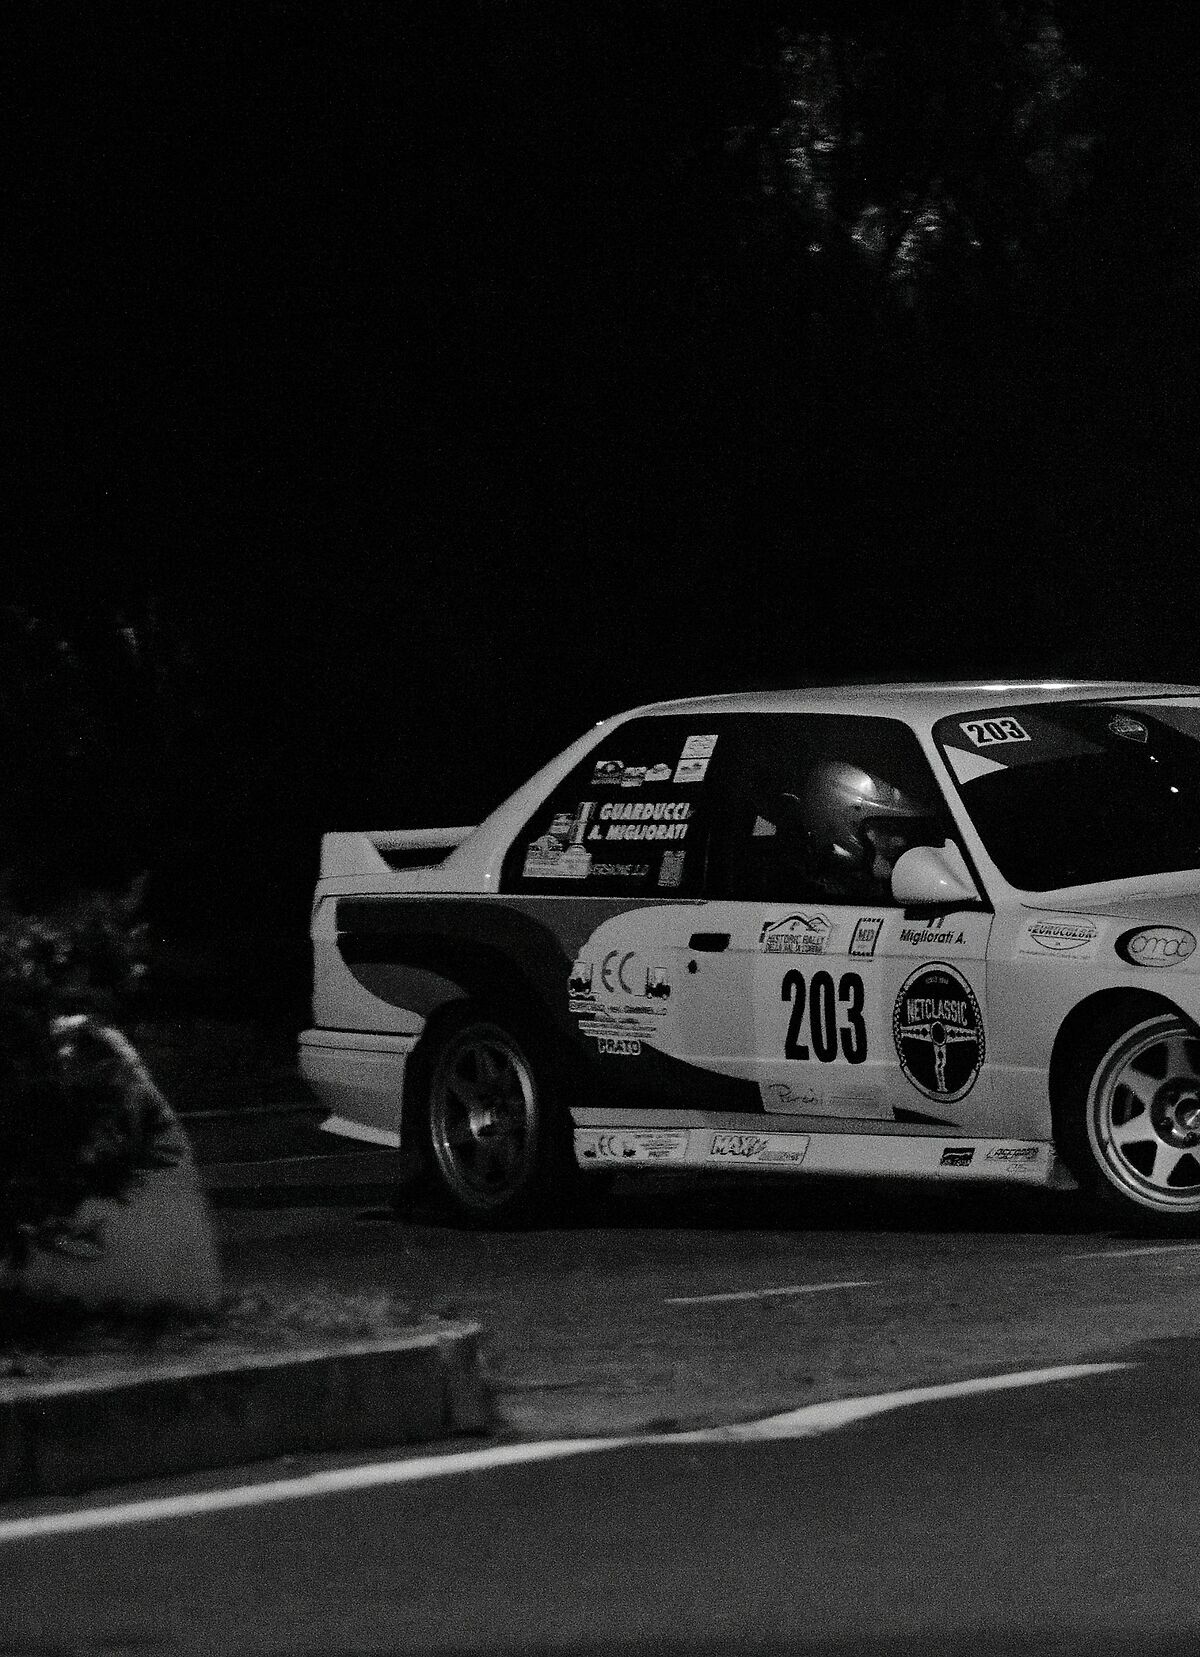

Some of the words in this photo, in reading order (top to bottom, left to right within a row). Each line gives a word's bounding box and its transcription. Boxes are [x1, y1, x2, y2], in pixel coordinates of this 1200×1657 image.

[967, 720, 1026, 743] 203
[600, 802, 691, 821] GUARDUCCI
[587, 824, 603, 841] A.
[605, 823, 689, 841] MIGLIORATI
[899, 928, 954, 945] Migliorati
[955, 931, 967, 946] A.
[781, 968, 868, 1065] 203
[906, 998, 968, 1027] NETCLASSIC
[599, 1038, 641, 1055] PRATO
